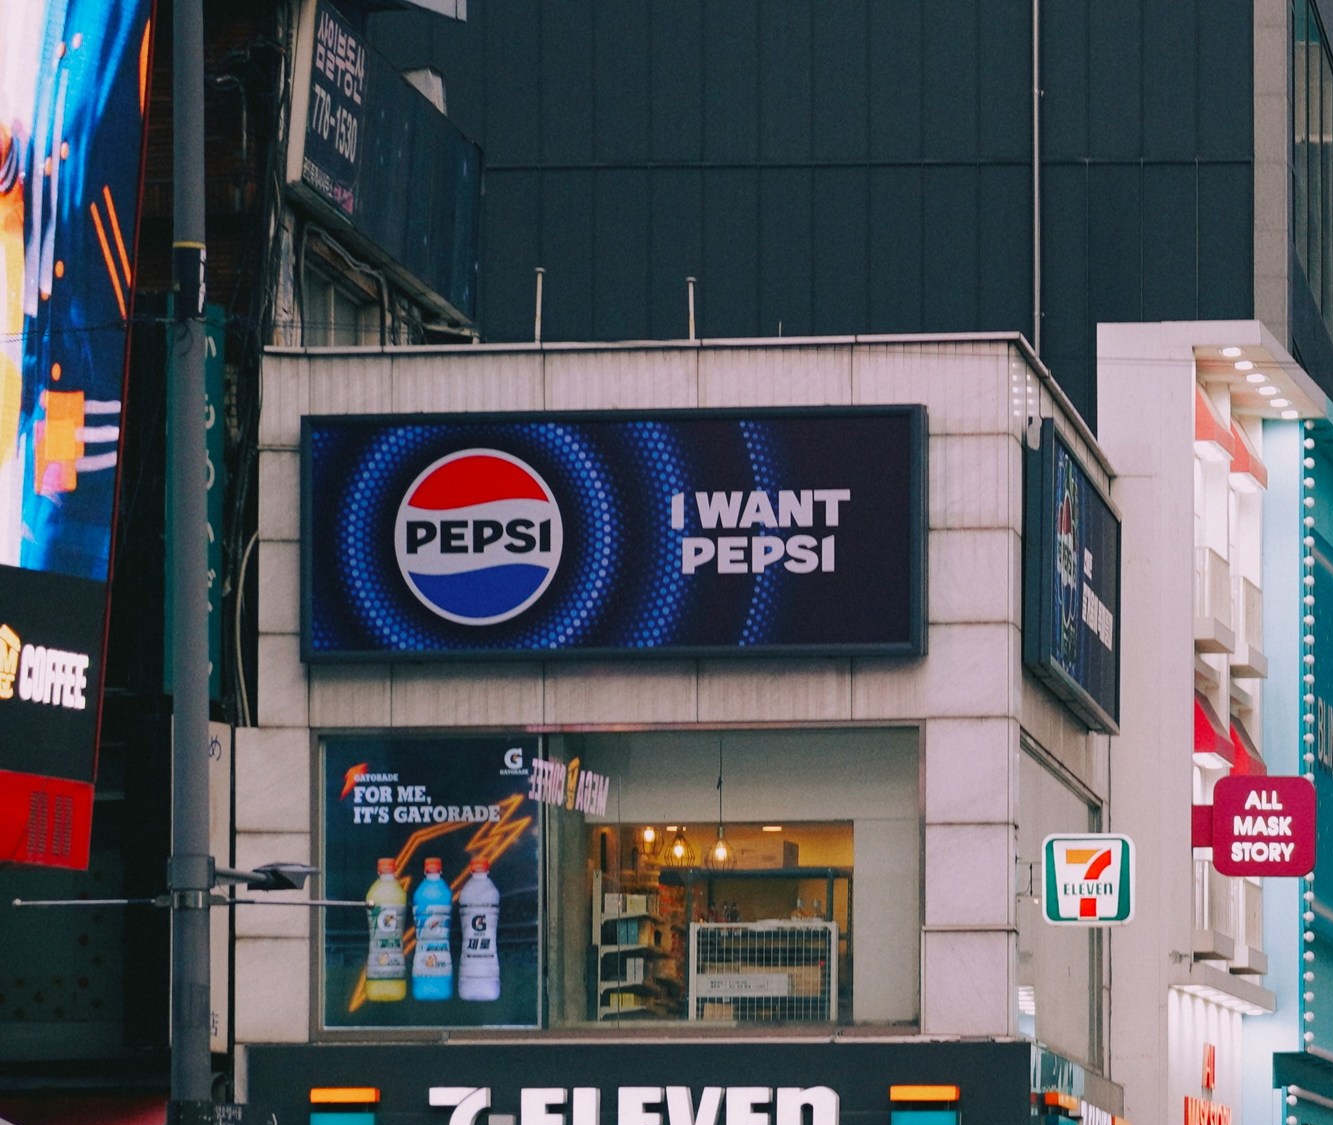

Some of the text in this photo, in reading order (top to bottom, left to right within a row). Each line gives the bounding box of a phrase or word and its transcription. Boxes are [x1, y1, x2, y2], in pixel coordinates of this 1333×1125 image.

[312, 83, 357, 164] 778-1530
[671, 489, 851, 529] I WANT
[406, 518, 551, 554] PEPSI
[681, 534, 835, 574] PEPSI
[19, 643, 89, 709] COFFEE
[354, 773, 398, 782] GATORADE
[354, 786, 431, 804] FOR ME,
[1245, 790, 1283, 810] ALL
[394, 805, 500, 823] GATORADE
[1233, 815, 1292, 836] MASK
[1231, 841, 1295, 862] STORY
